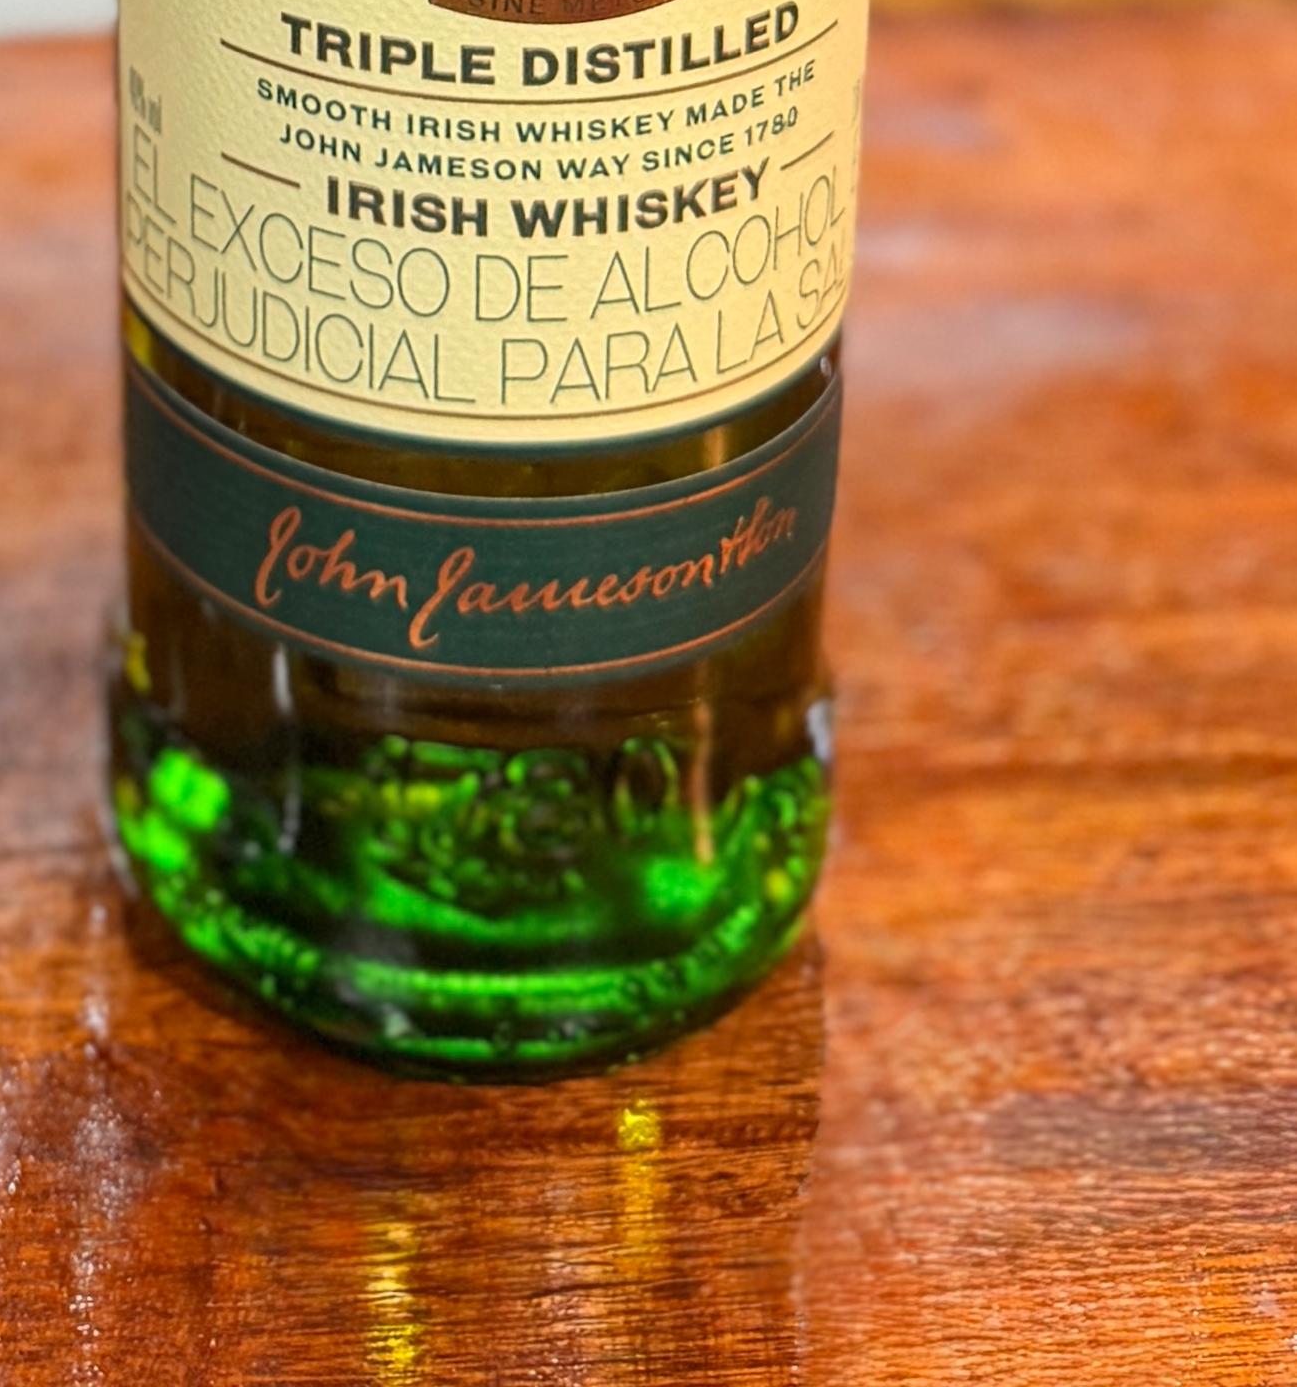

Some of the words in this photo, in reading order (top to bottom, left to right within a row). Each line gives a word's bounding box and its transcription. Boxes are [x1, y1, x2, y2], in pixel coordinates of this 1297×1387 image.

[280, 11, 496, 86] TRIPLE
[521, 0, 800, 87] DISTILLED
[257, 77, 391, 132] SMOOTH
[407, 113, 500, 143] IRISH
[516, 109, 675, 143] WHISKEY
[685, 85, 765, 127] MADE
[774, 58, 816, 98] THE
[279, 123, 361, 163] JOHN
[375, 147, 542, 181] JAMESON
[557, 153, 630, 181] WAY
[641, 133, 735, 173] SINCE
[744, 105, 799, 148] 1780
[132, 123, 177, 225] EL
[190, 173, 451, 317] EXCESO
[475, 253, 569, 323] DE
[590, 164, 845, 320] ALCOHOL
[326, 175, 488, 237] IRISH
[510, 156, 770, 239] WHISKEY
[125, 189, 477, 404] PERJUDICIAL
[501, 321, 698, 406] PARA
[716, 288, 785, 375] LA
[255, 506, 409, 609] John
[408, 546, 714, 651] Jameson
